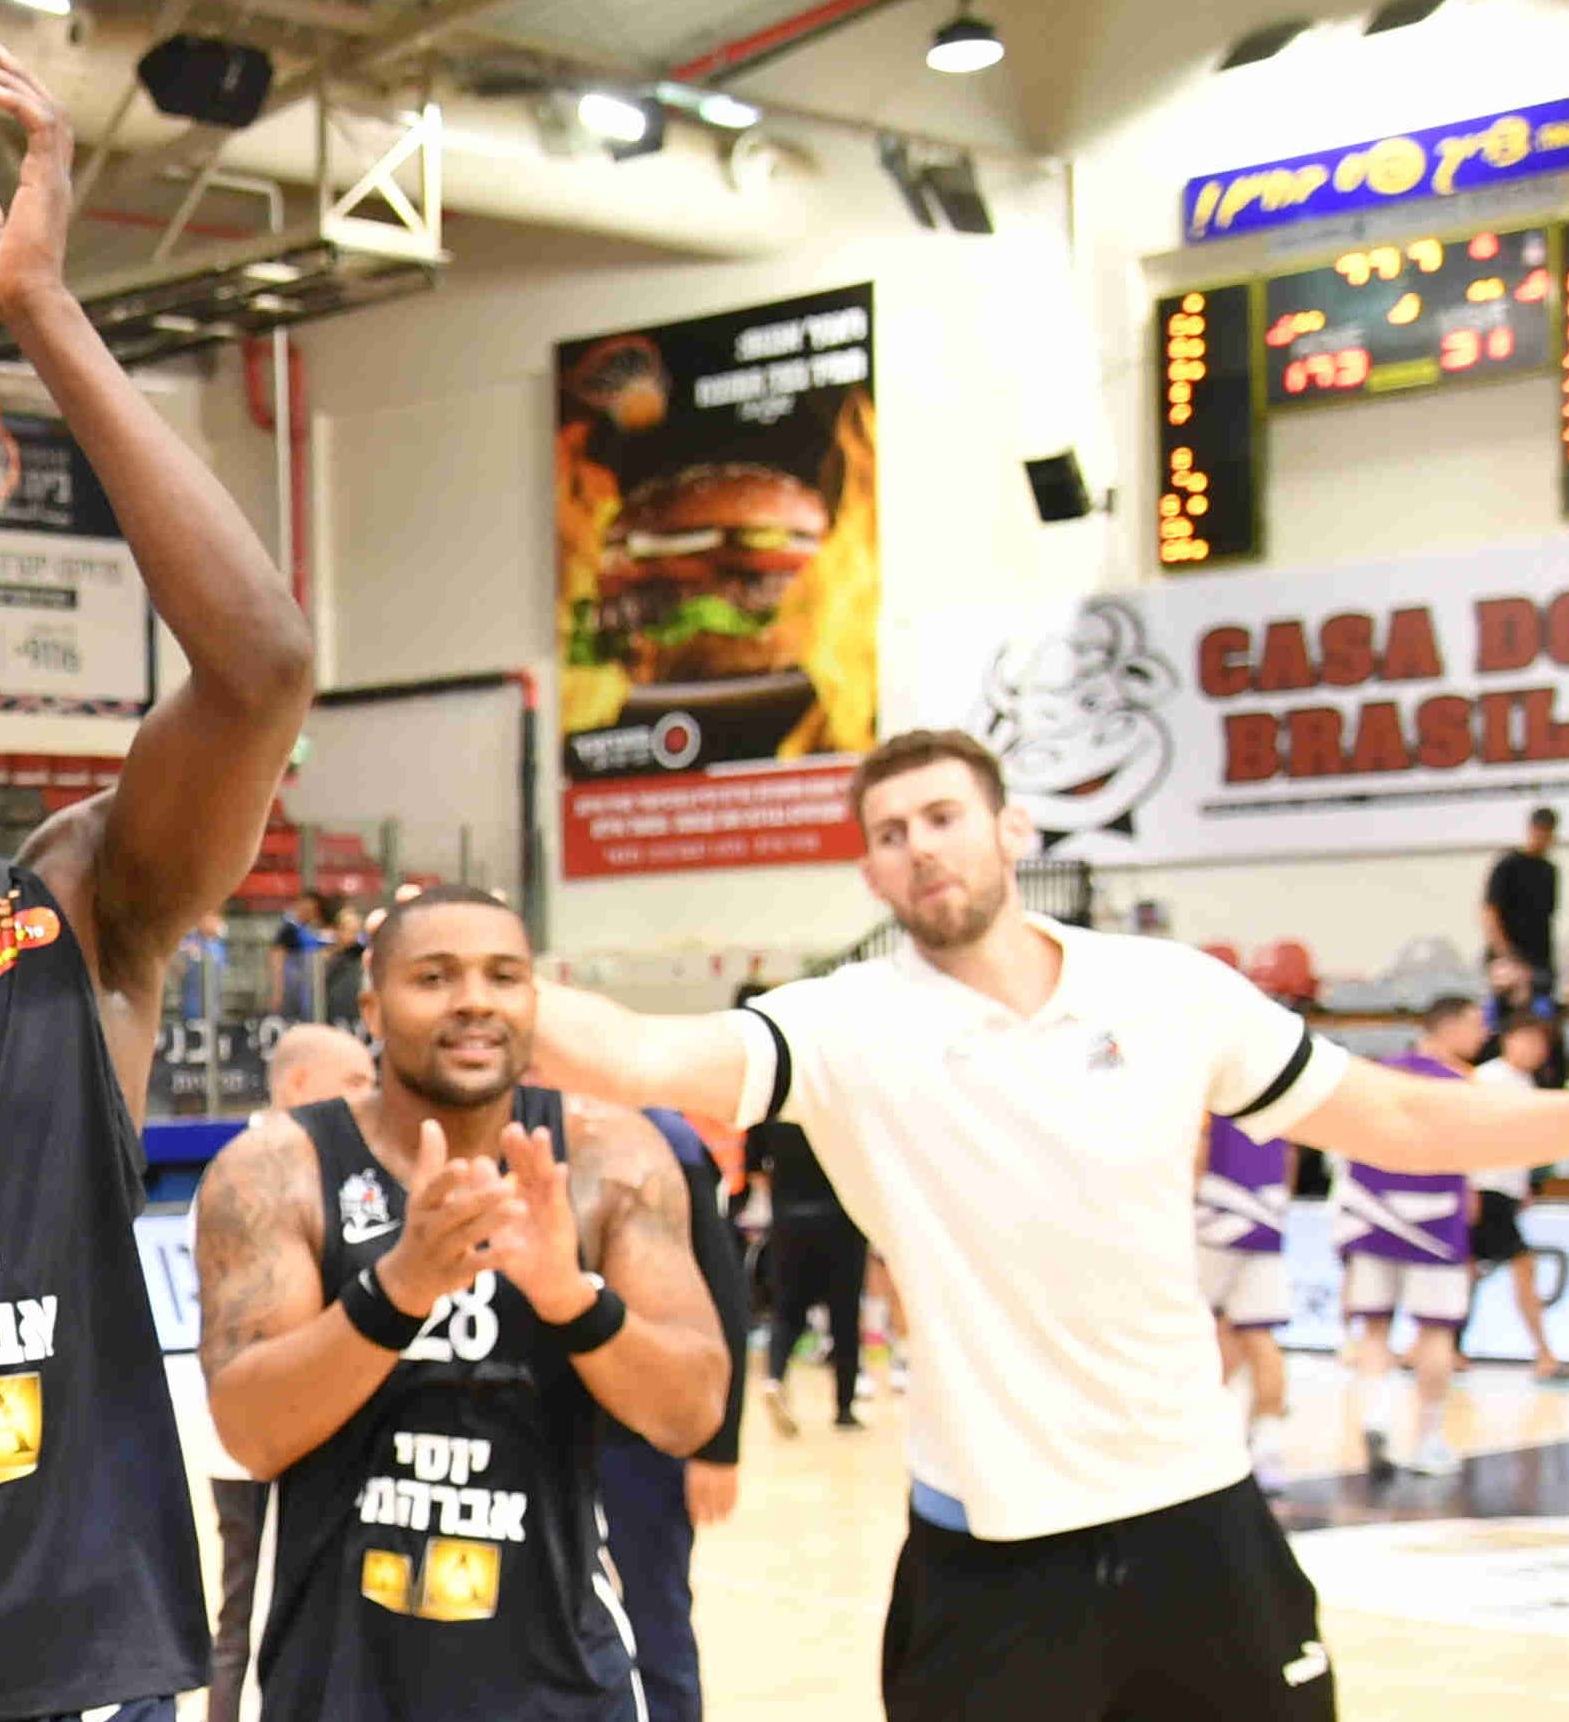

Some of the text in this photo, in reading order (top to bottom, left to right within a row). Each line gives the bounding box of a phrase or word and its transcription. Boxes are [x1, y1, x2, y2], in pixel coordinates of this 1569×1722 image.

[1200, 606, 1445, 699] CASA
[1224, 687, 1569, 784] BRASIL
[399, 1269, 499, 1361] 28
[393, 1431, 492, 1486] יוסי
